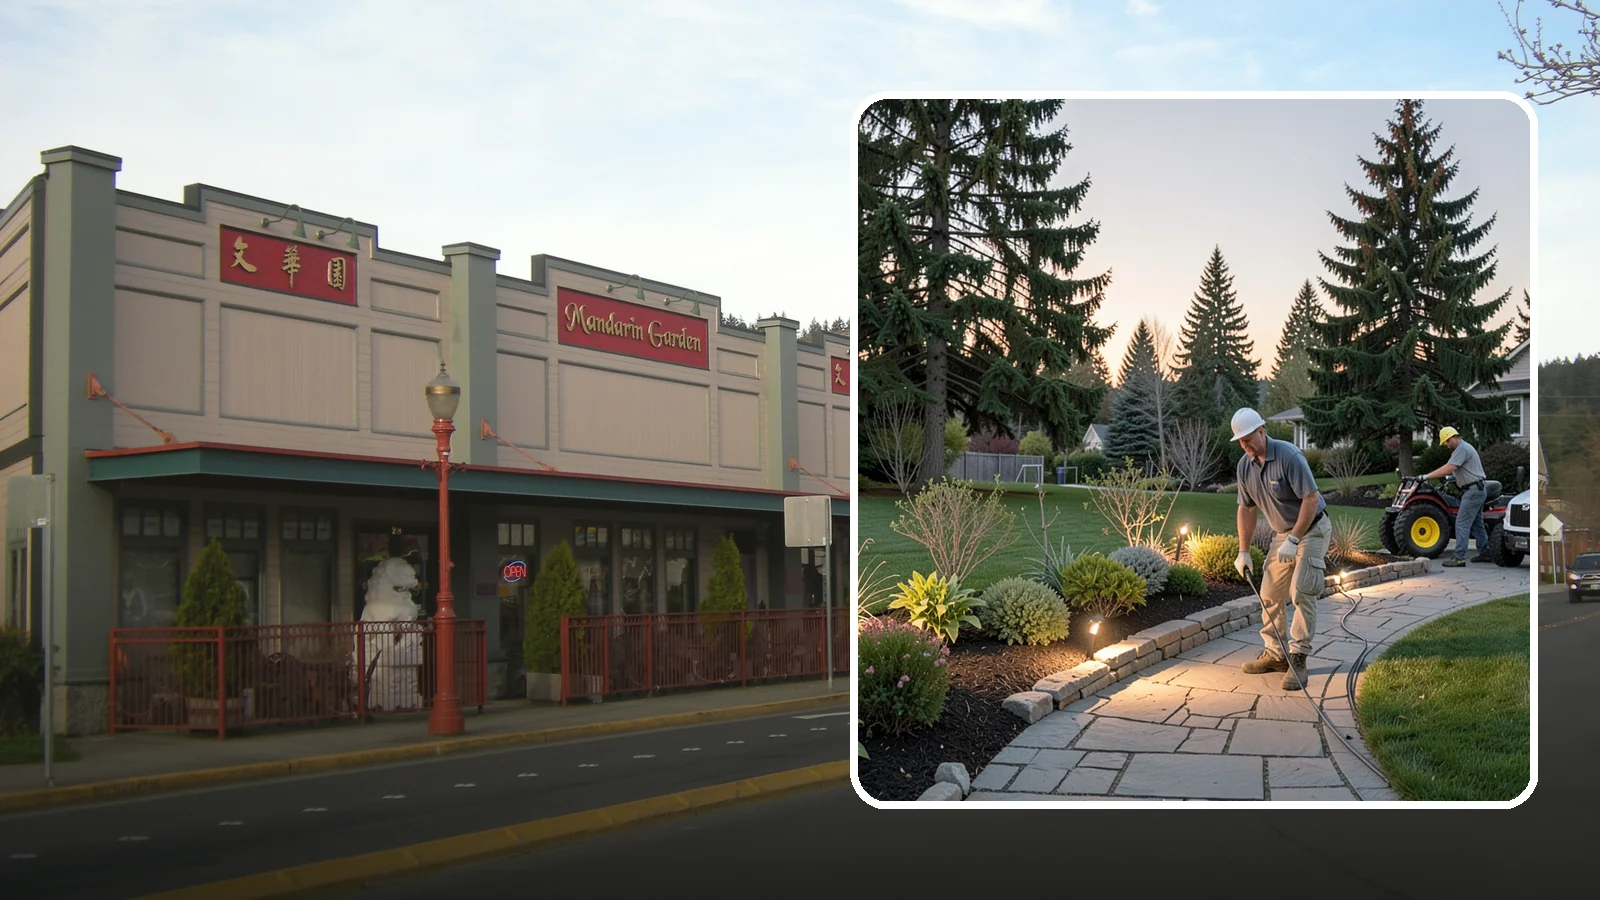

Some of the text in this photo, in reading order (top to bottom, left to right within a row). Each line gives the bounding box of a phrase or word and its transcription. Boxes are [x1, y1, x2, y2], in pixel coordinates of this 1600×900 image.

[230, 235, 347, 291] 文華園
[564, 302, 701, 352] Mandarin Garden
[834, 362, 846, 386] 文
[503, 565, 527, 578] OPEN
